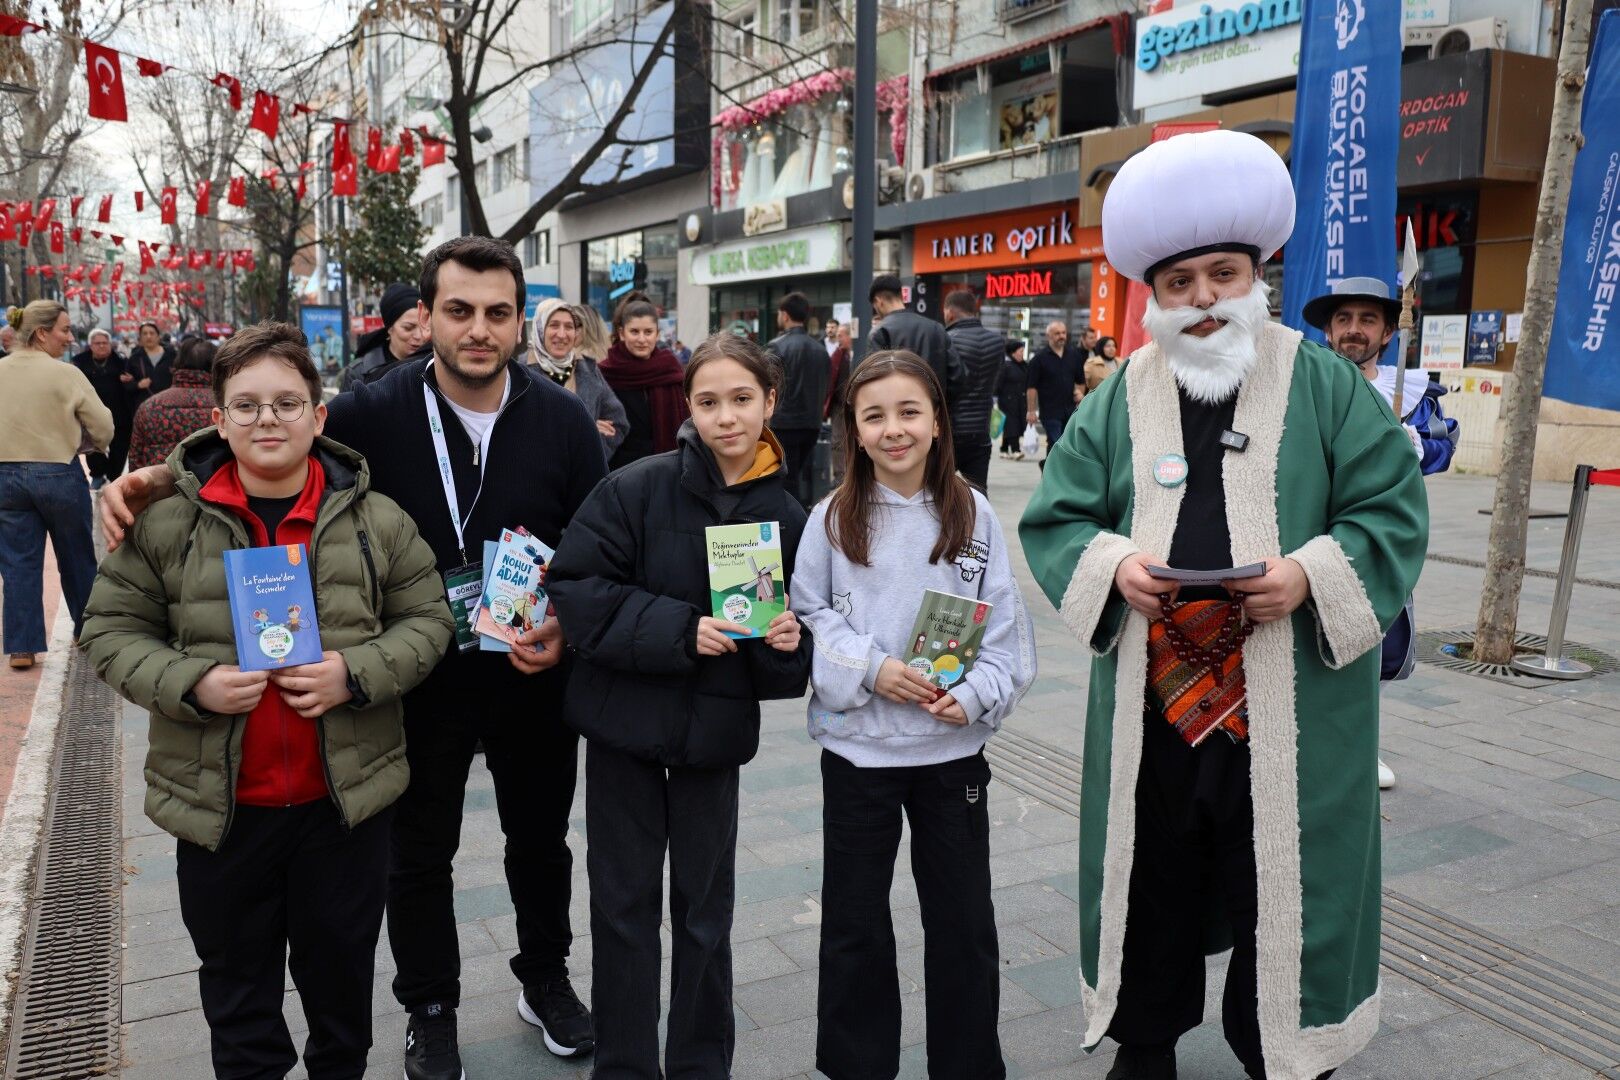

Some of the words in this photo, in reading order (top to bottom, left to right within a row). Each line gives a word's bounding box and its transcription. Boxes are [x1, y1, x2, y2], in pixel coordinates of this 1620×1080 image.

[1399, 91, 1469, 117] RDOĞAN
[1403, 116, 1451, 139] OPTİK
[932, 232, 995, 259] TAMER
[1584, 216, 1603, 264] OLUYOR
[985, 270, 1053, 299] İNDİRİM
[502, 553, 534, 574] NOHUT
[242, 576, 253, 586] La
